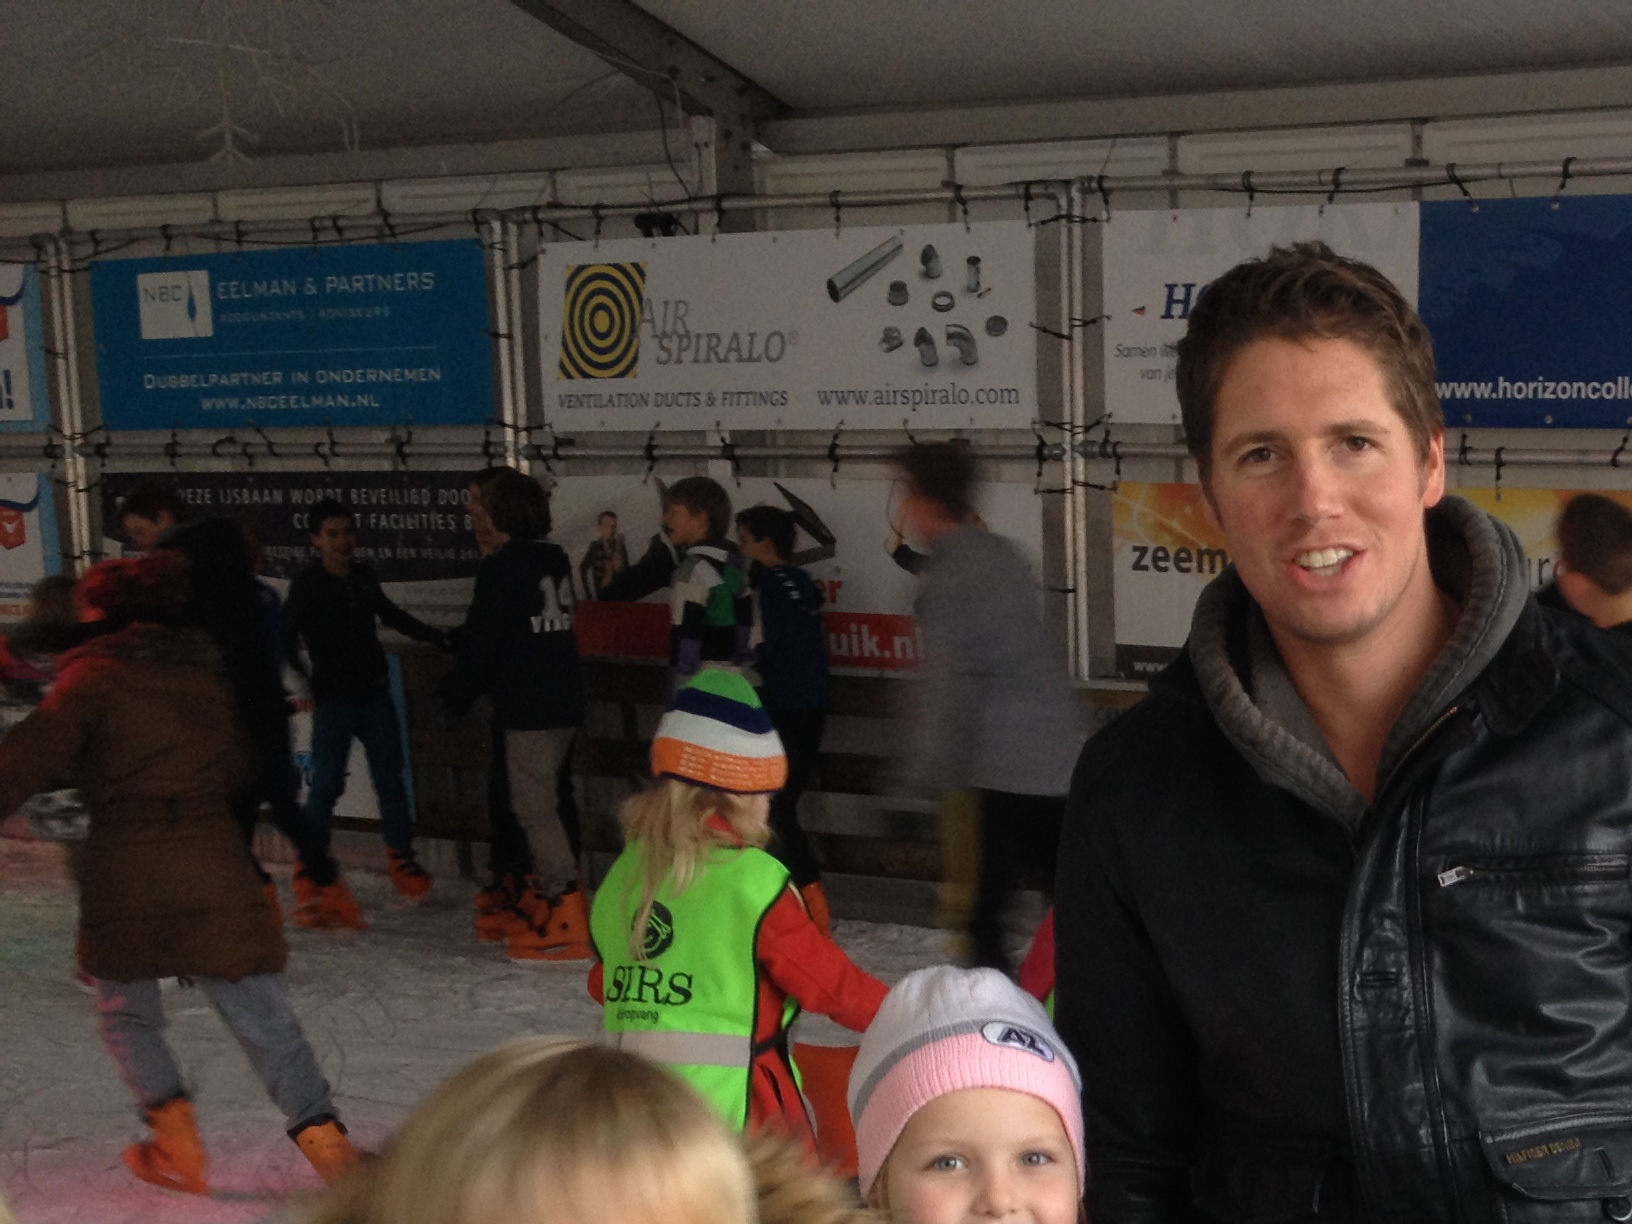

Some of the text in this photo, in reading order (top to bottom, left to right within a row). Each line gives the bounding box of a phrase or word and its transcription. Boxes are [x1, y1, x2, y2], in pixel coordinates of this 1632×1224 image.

[217, 271, 435, 300] EELMAN & PARTNERS
[640, 299, 690, 338] AIR
[291, 370, 309, 385] IN
[316, 367, 441, 385] ONDERNEMEN
[559, 390, 789, 409] VENTILATION DUCTS & FITTINGS
[817, 382, 1021, 412] www.airspiralo.com
[438, 488, 472, 505] DOO
[1131, 545, 1228, 574] zeem
[828, 623, 924, 659] uik.nl
